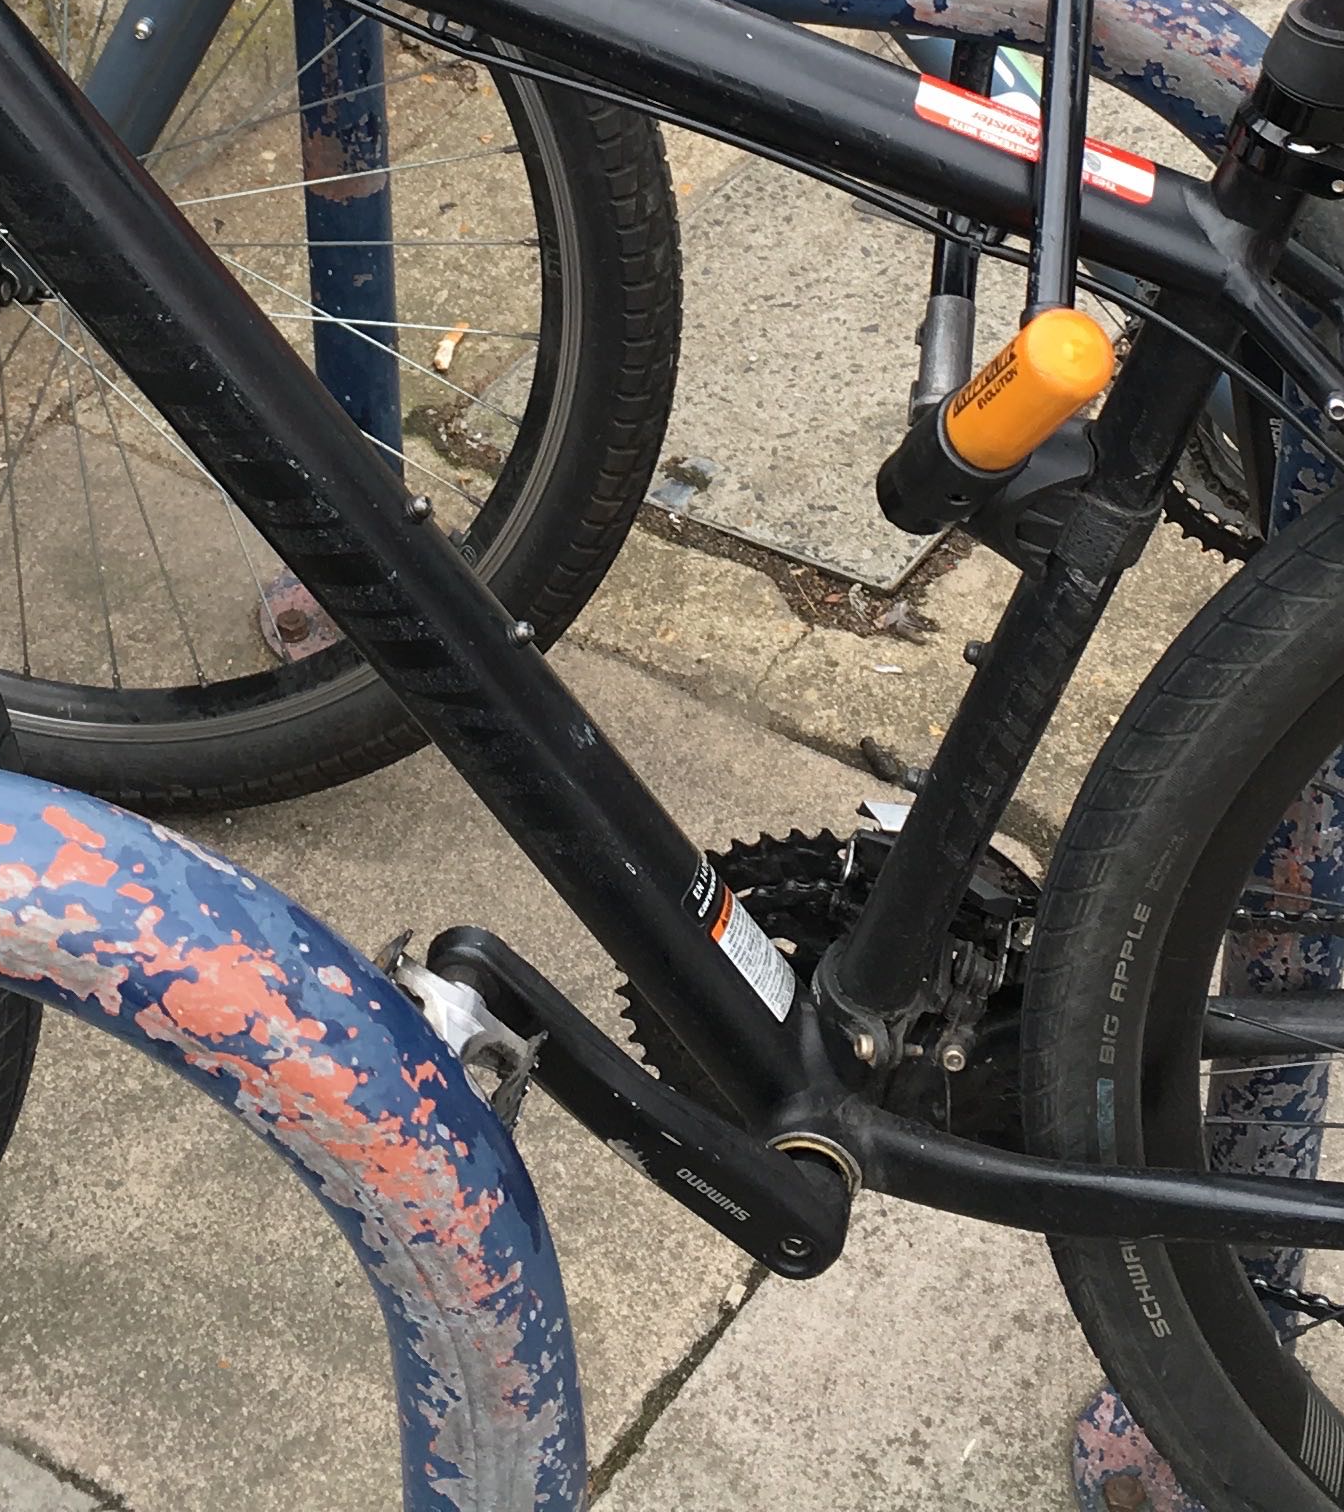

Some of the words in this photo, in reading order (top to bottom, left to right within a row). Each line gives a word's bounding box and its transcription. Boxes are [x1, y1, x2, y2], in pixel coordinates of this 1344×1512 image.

[977, 368, 1018, 410] EVOLUTION
[692, 881, 705, 901] EN
[1109, 902, 1152, 1003] APPLE
[1099, 1014, 1120, 1065] BIG
[675, 1167, 752, 1222] SHIMANO
